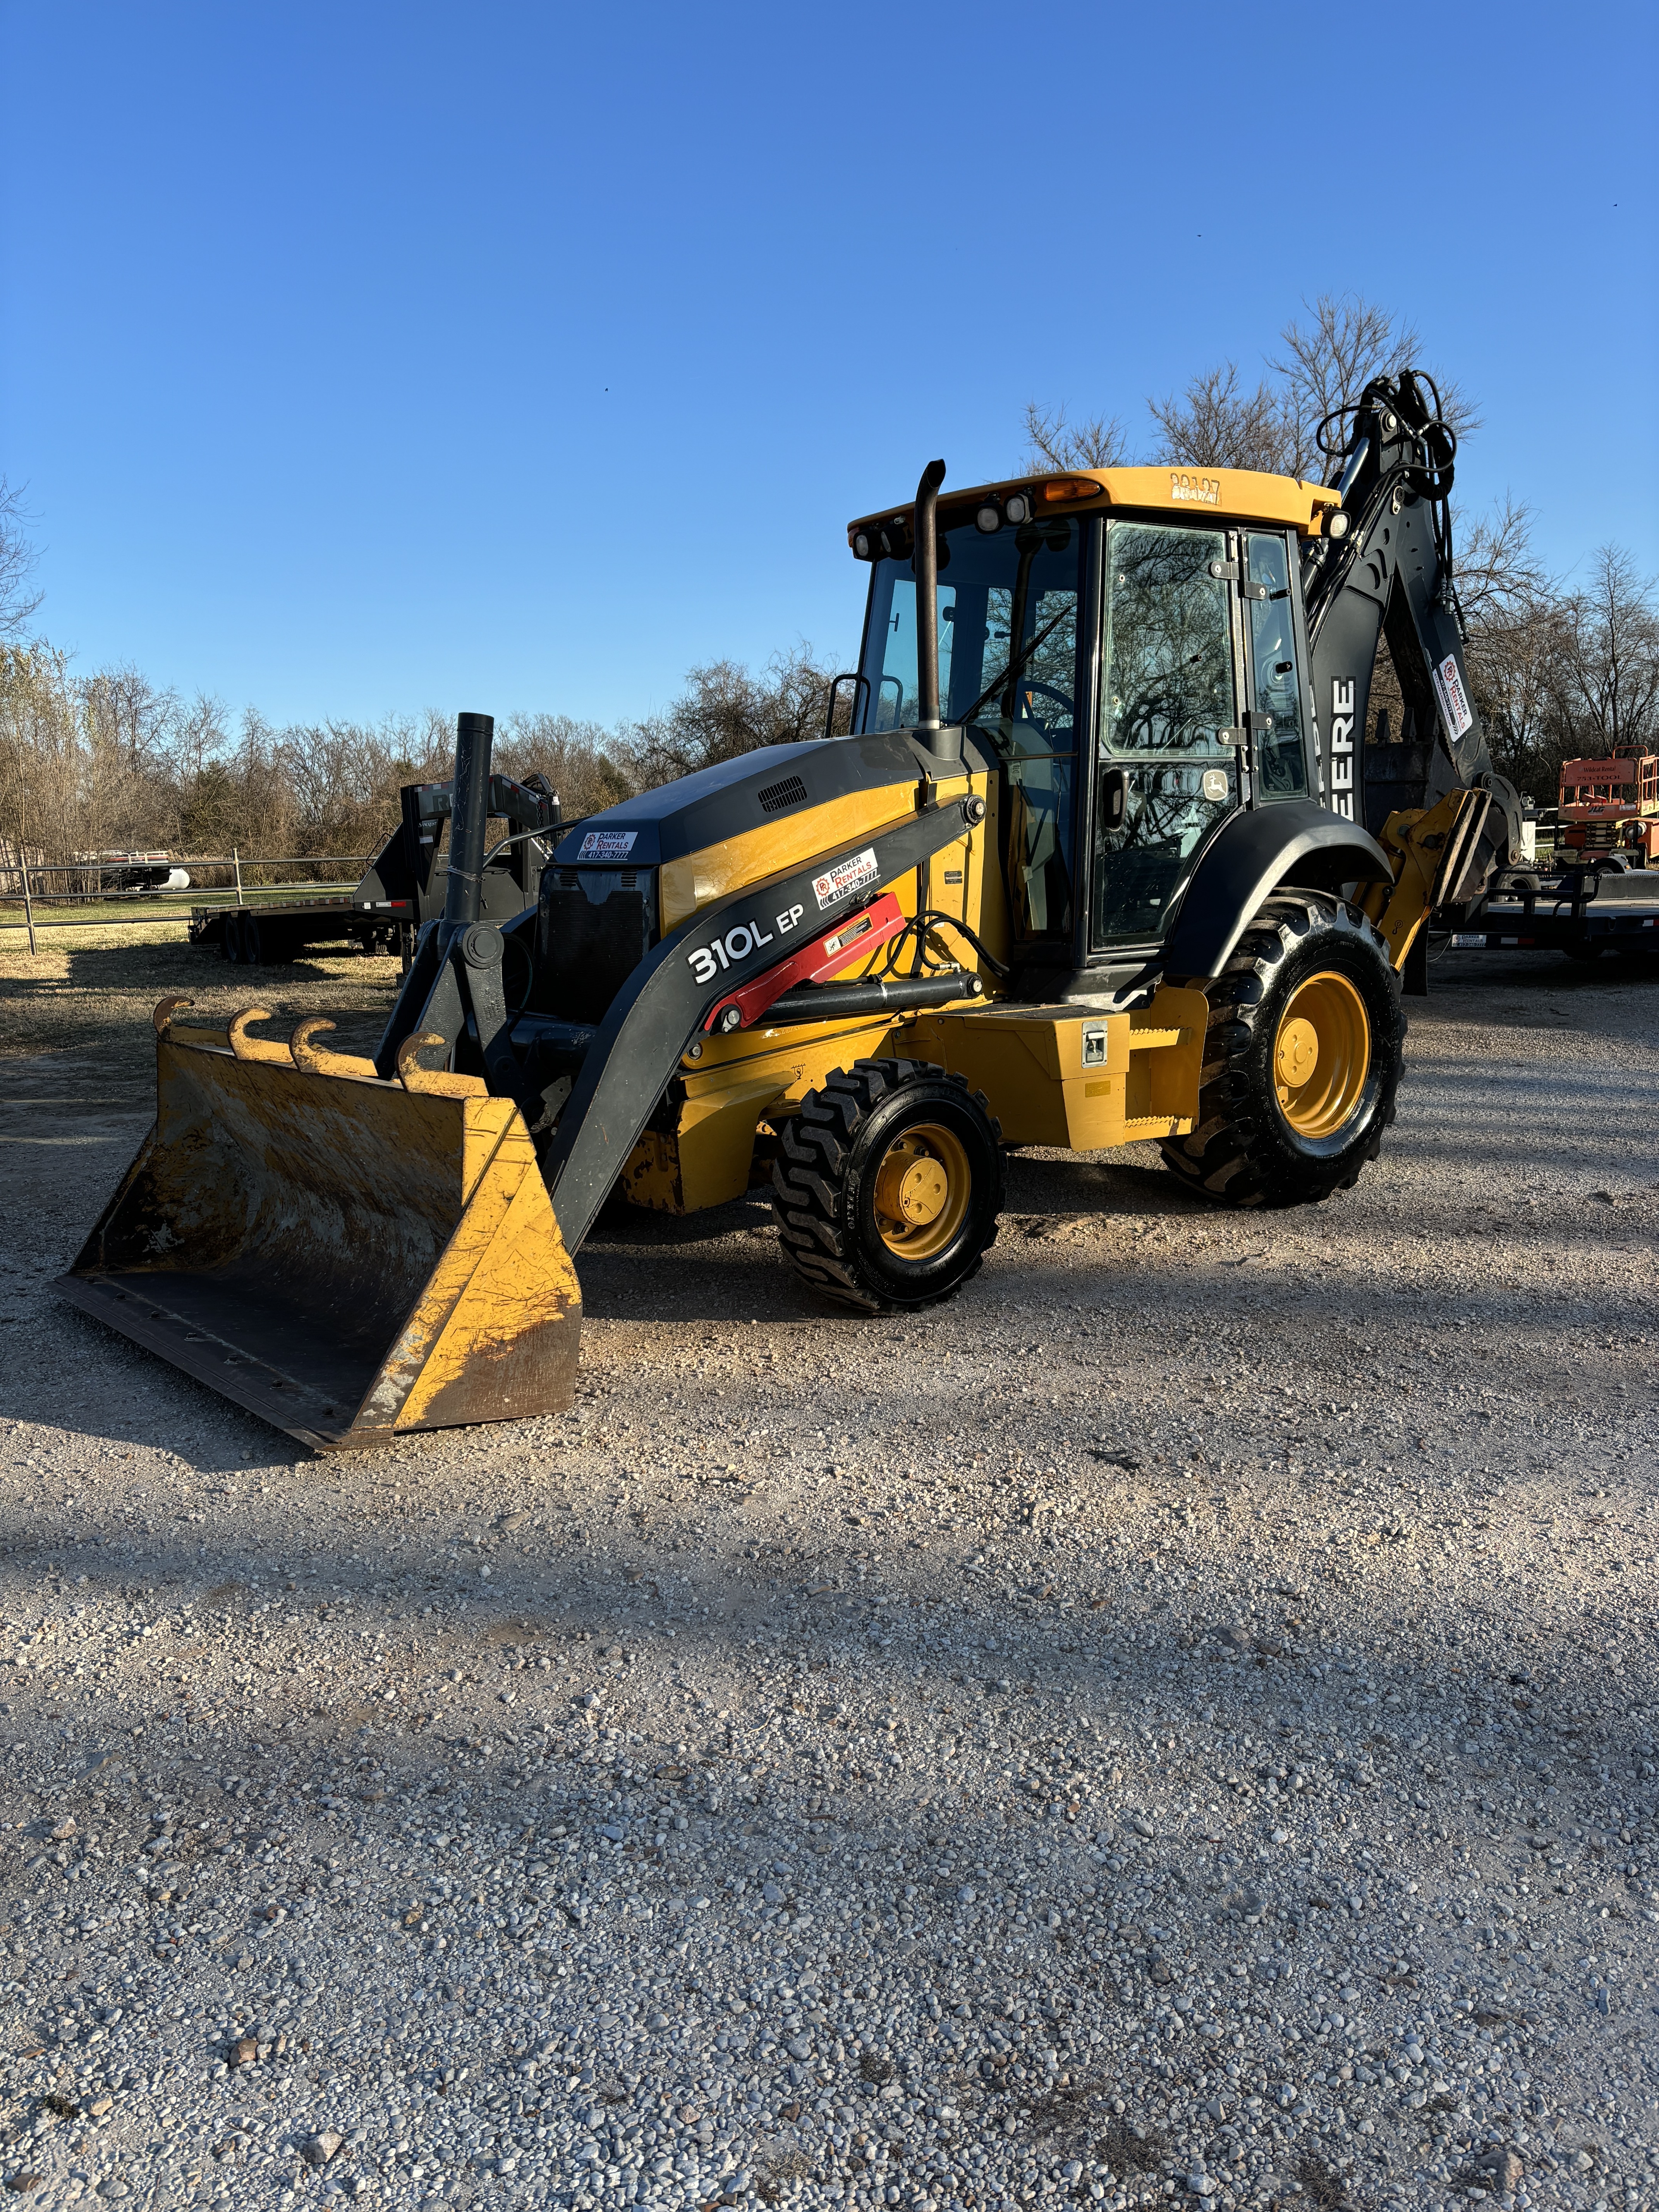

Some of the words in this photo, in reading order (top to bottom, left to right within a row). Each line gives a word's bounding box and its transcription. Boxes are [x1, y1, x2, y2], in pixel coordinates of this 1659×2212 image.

[1440, 680, 1452, 713] 417-340-7777
[1450, 685, 1465, 729] RENTALS
[1453, 678, 1467, 716] PARKER
[596, 840, 629, 850] RENTALS
[597, 833, 626, 843] PARKER
[830, 856, 862, 883] PARKER
[832, 868, 877, 900] 417-340-7777
[835, 862, 872, 888] RENTALS
[688, 921, 774, 984] 310L
[776, 904, 804, 934] EP
